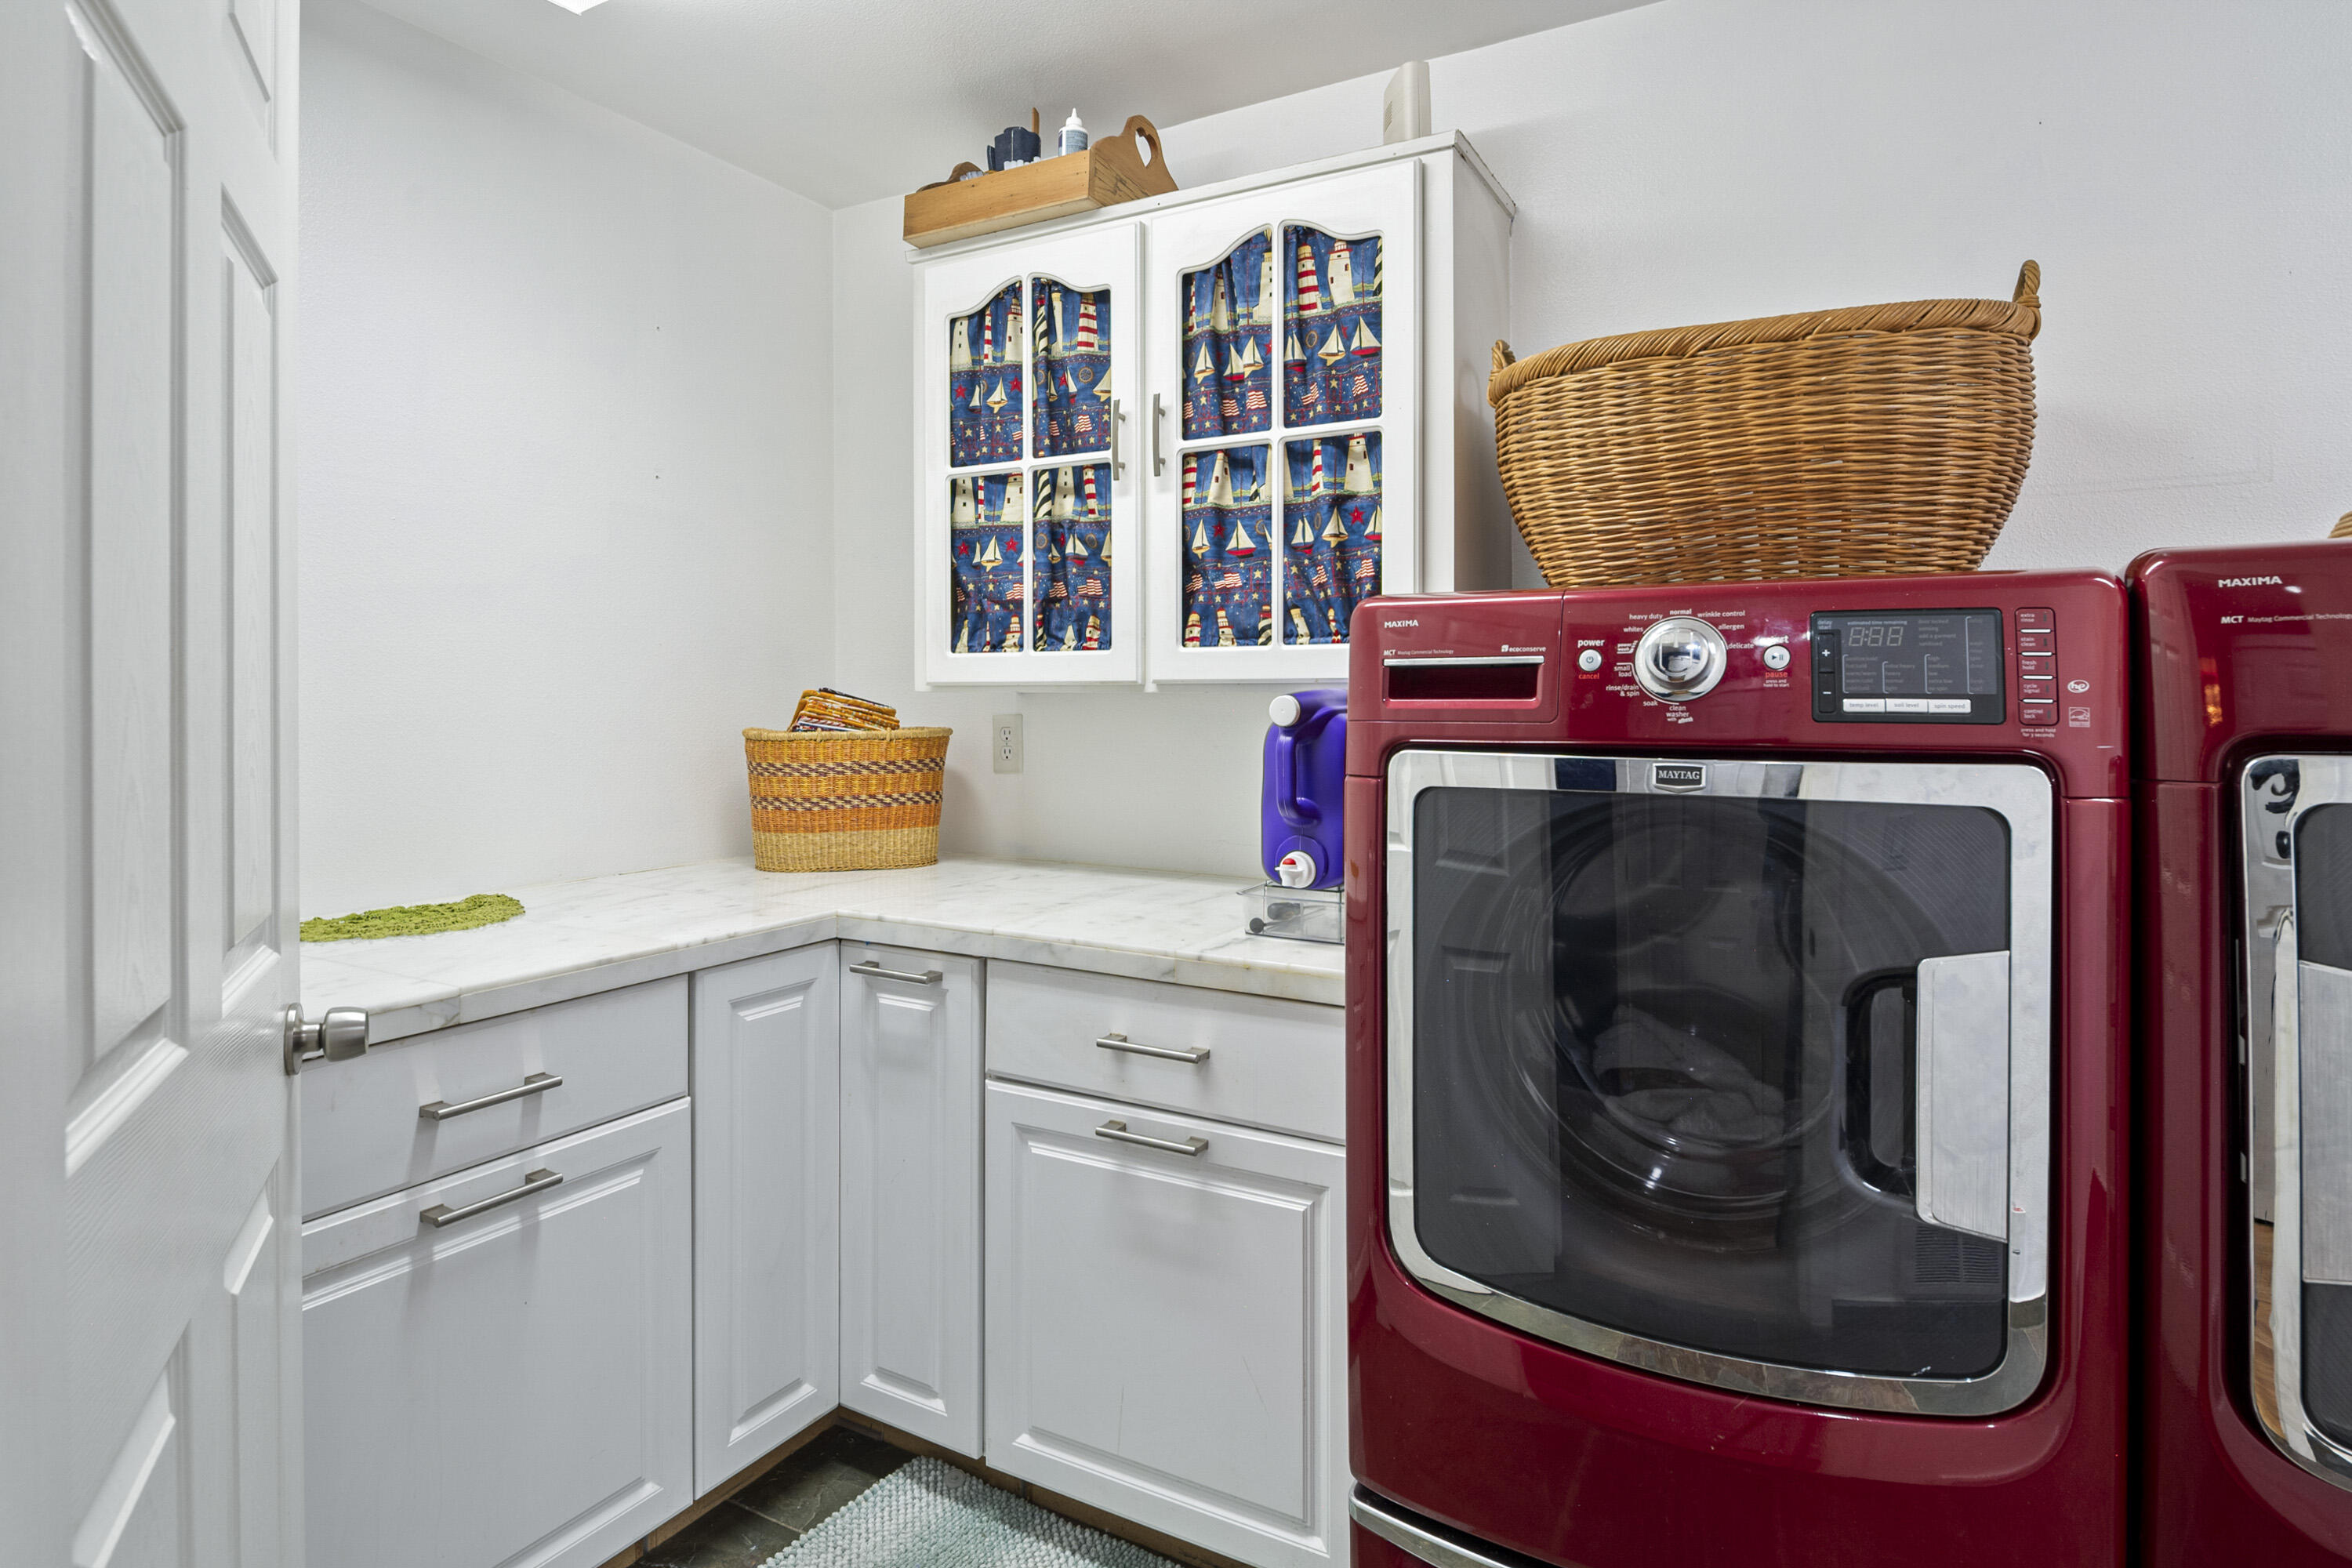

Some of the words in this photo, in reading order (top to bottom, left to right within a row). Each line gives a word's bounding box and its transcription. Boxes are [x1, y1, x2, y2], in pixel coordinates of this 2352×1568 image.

[2218, 575, 2283, 588] MAXIMA
[1385, 619, 1418, 628] MAXIMA
[2220, 615, 2244, 624] MCT
[1577, 639, 1605, 648] power
[1658, 770, 1700, 779] MAYTAG
